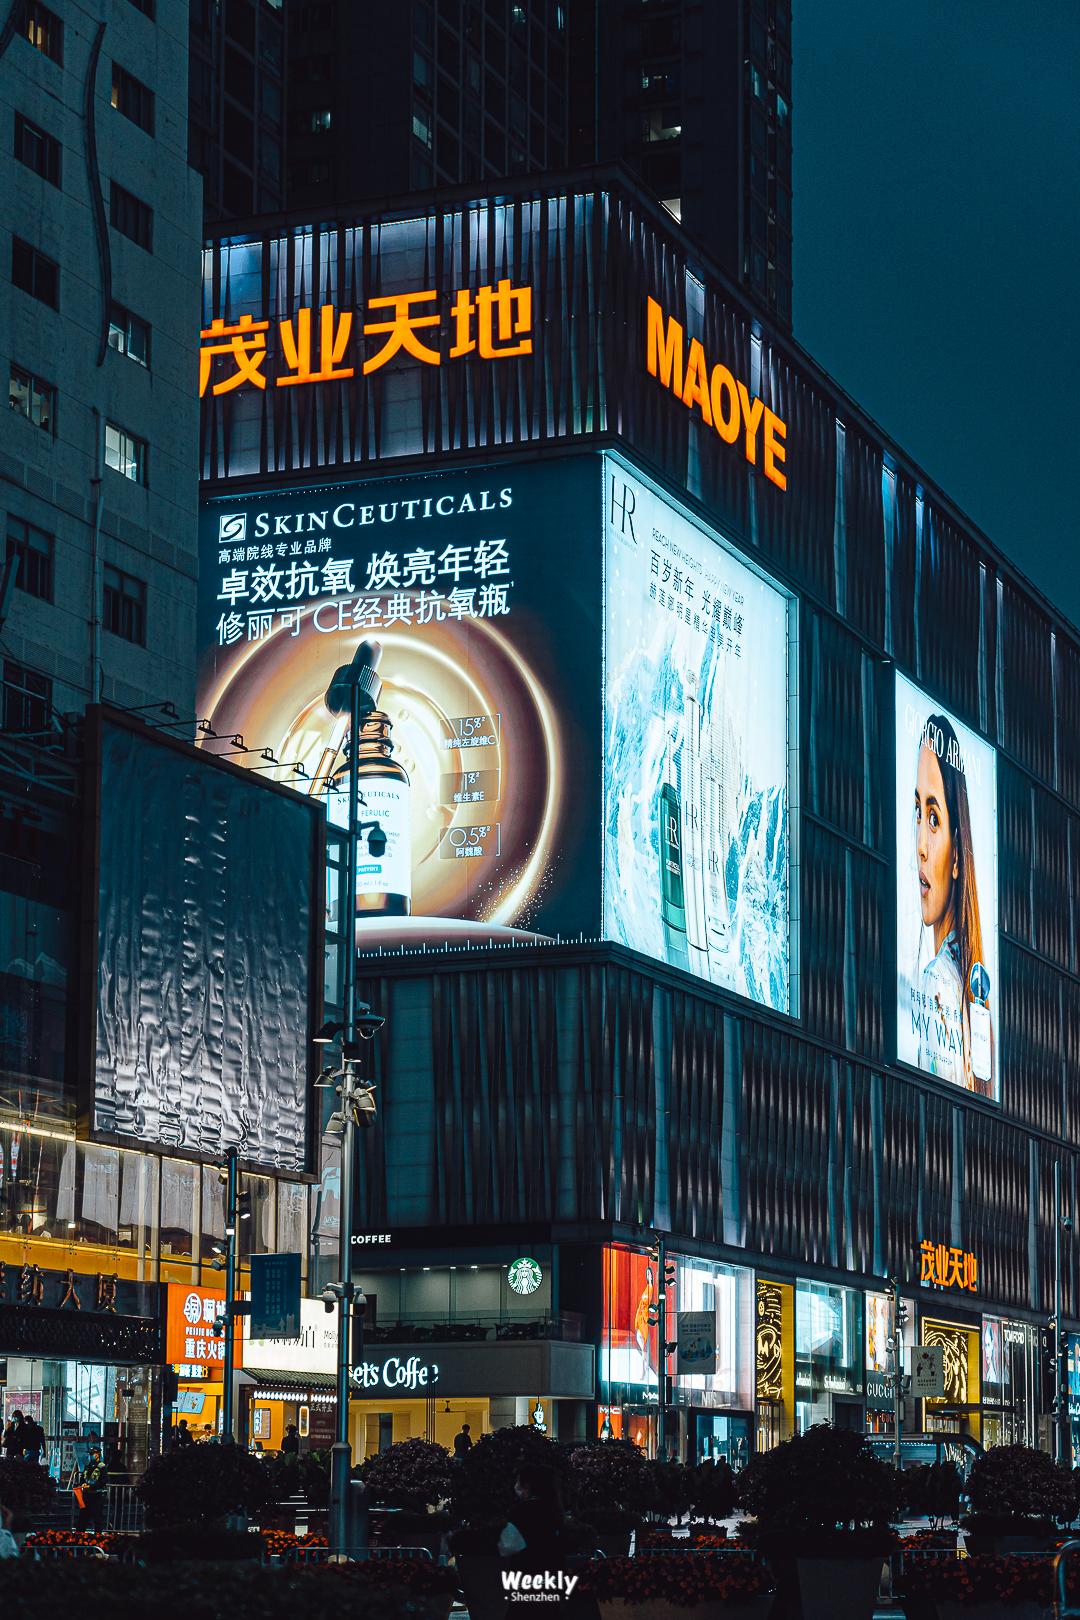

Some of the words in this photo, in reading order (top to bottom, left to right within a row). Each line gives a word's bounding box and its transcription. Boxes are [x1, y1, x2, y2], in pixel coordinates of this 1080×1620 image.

[199, 279, 533, 397] 茂业天地
[647, 296, 787, 492] MAOYE
[254, 488, 513, 537] SKINCEUTICALS
[611, 474, 637, 544] HR
[217, 558, 355, 605] 卓效抗氧
[365, 539, 510, 591] 焕亮年轻
[218, 537, 332, 564] 高端院线专业品牌
[216, 602, 305, 645] 修丽可
[911, 1009, 931, 1041] MY
[934, 1019, 963, 1057] WAY
[350, 1234, 392, 1245] COFFEE
[921, 1239, 977, 1292] 茂业天地
[867, 1382, 895, 1398] GUCCI
